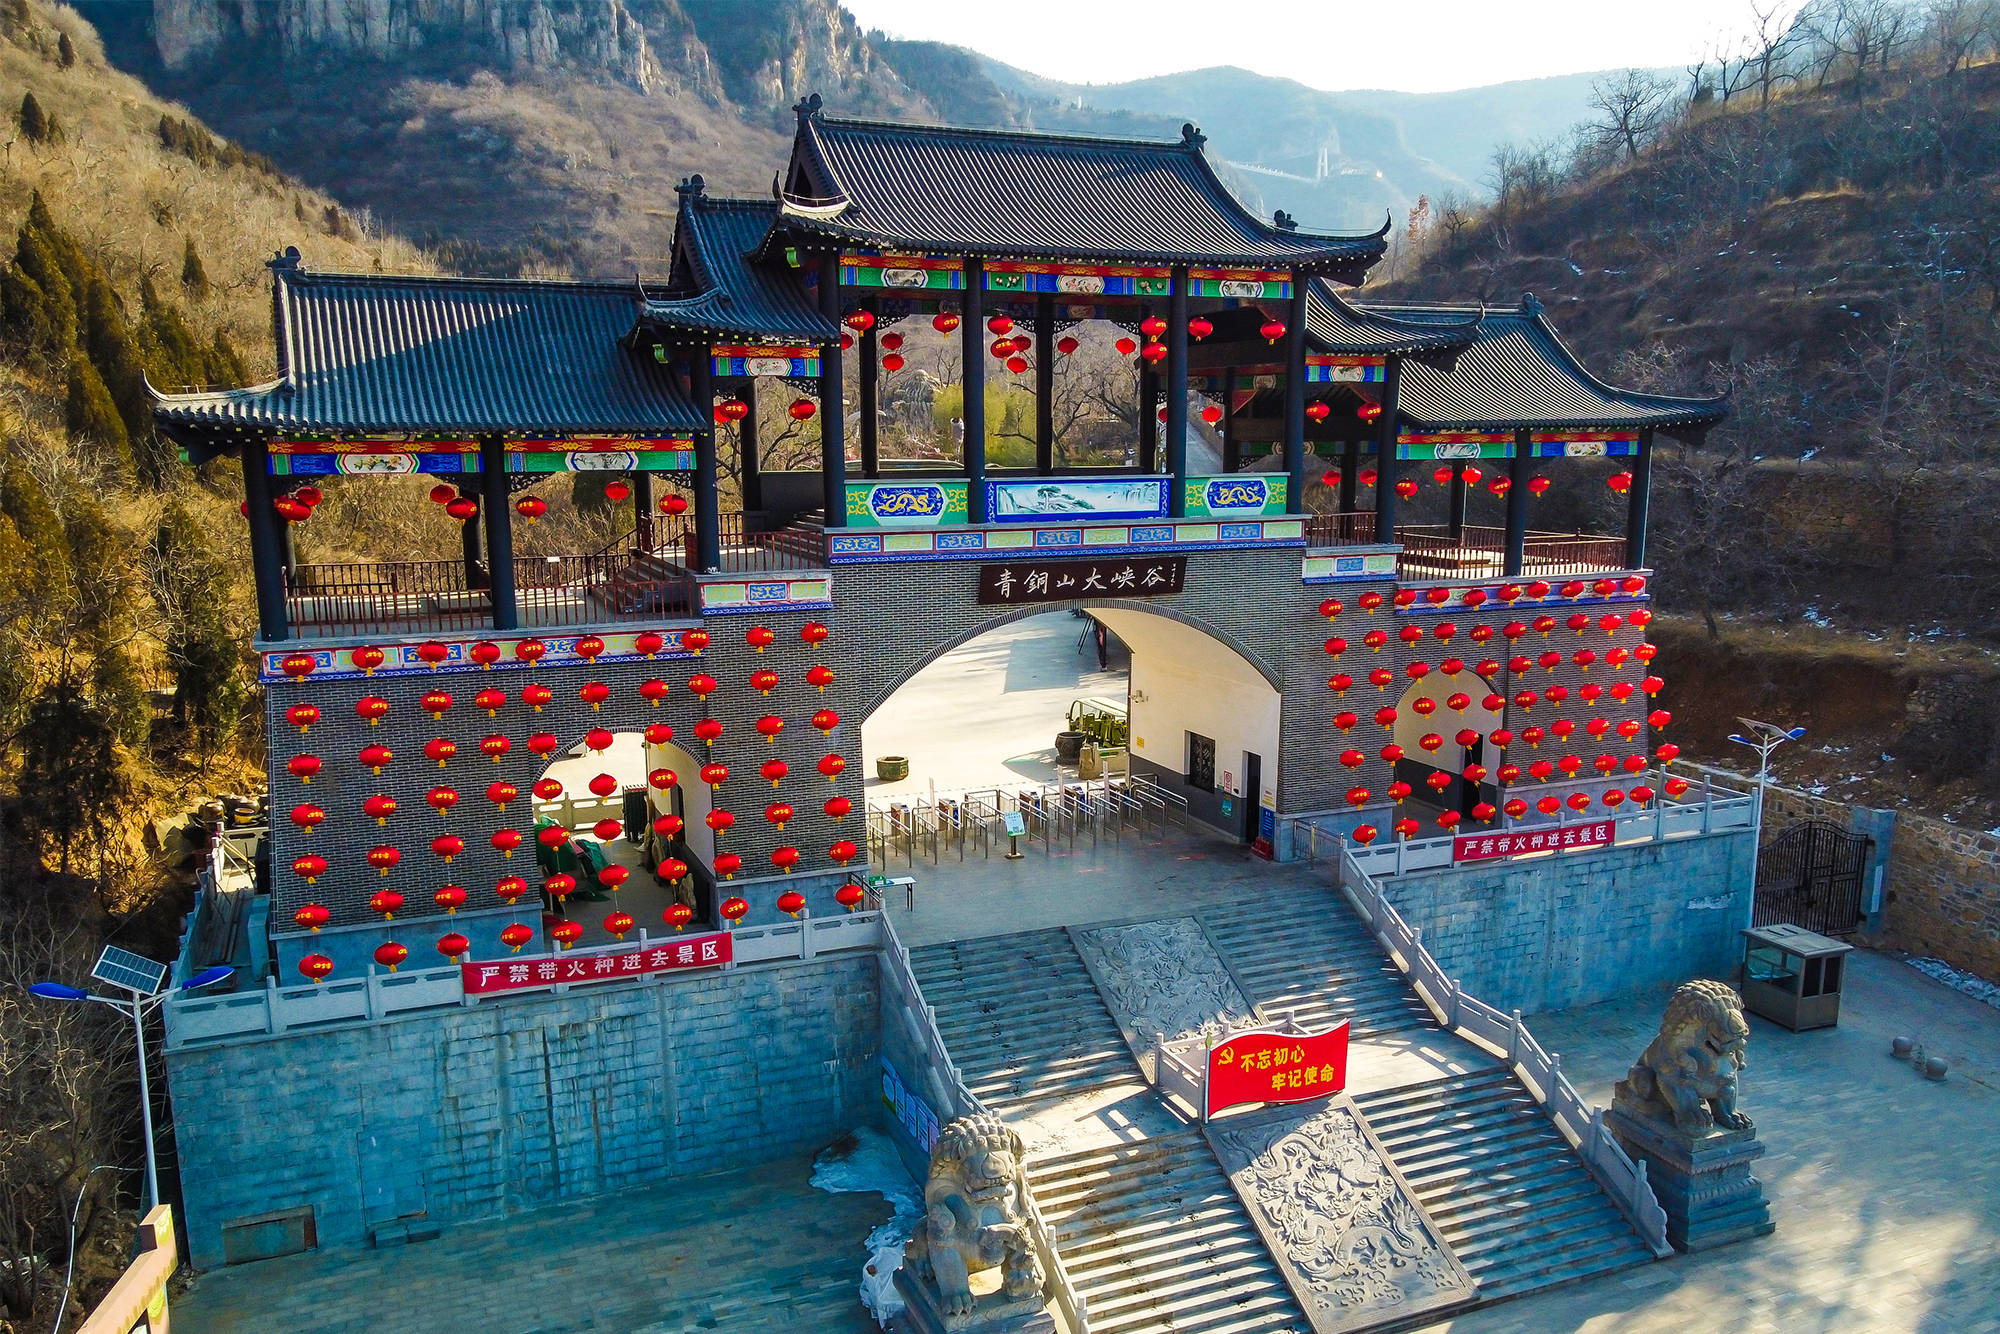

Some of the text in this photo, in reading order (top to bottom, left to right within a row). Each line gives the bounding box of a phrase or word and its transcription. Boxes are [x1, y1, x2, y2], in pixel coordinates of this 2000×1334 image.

[480, 940, 719, 987] 严禁带火种进去景区
[1240, 1044, 1306, 1073] 不忘初心
[1271, 1063, 1335, 1091] 牢记使命
